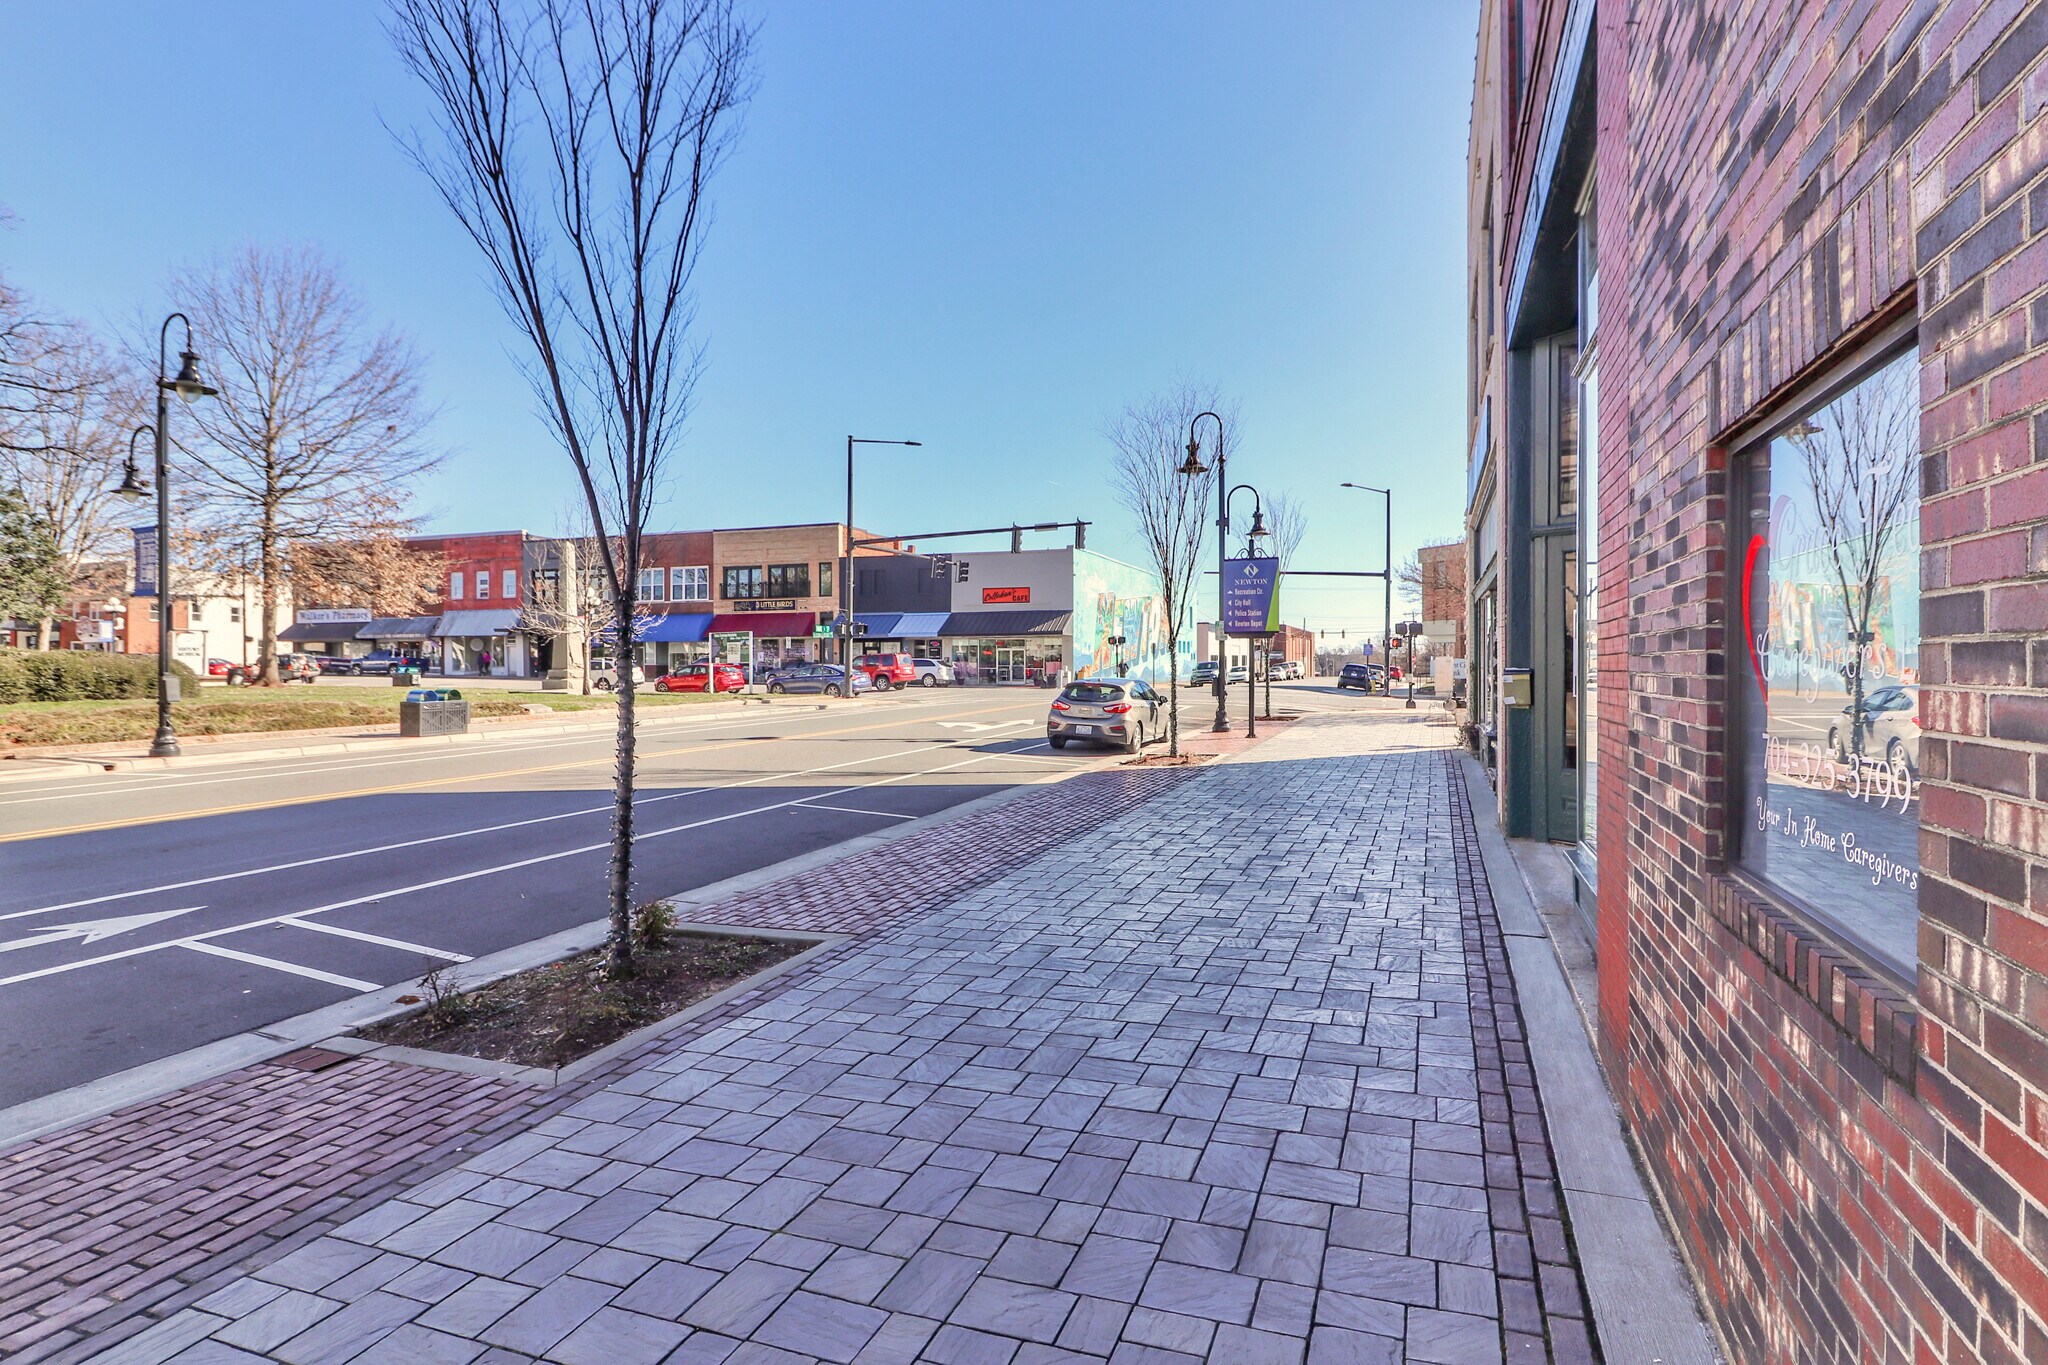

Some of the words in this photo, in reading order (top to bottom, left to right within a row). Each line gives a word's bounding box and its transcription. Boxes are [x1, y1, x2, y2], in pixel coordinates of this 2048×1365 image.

[1234, 578, 1268, 586] NEWTON
[300, 611, 329, 620] Walker's
[332, 611, 369, 620] Pharmacy
[755, 601, 760, 609] 3
[776, 600, 793, 608] BIRDS
[1757, 628, 1886, 704] Caregivers
[1762, 733, 1911, 814] 704-325-3799
[1756, 797, 1781, 831] Your
[1784, 808, 1798, 835] In
[1801, 815, 1836, 852] Home
[1841, 832, 1919, 890] Caregivers
